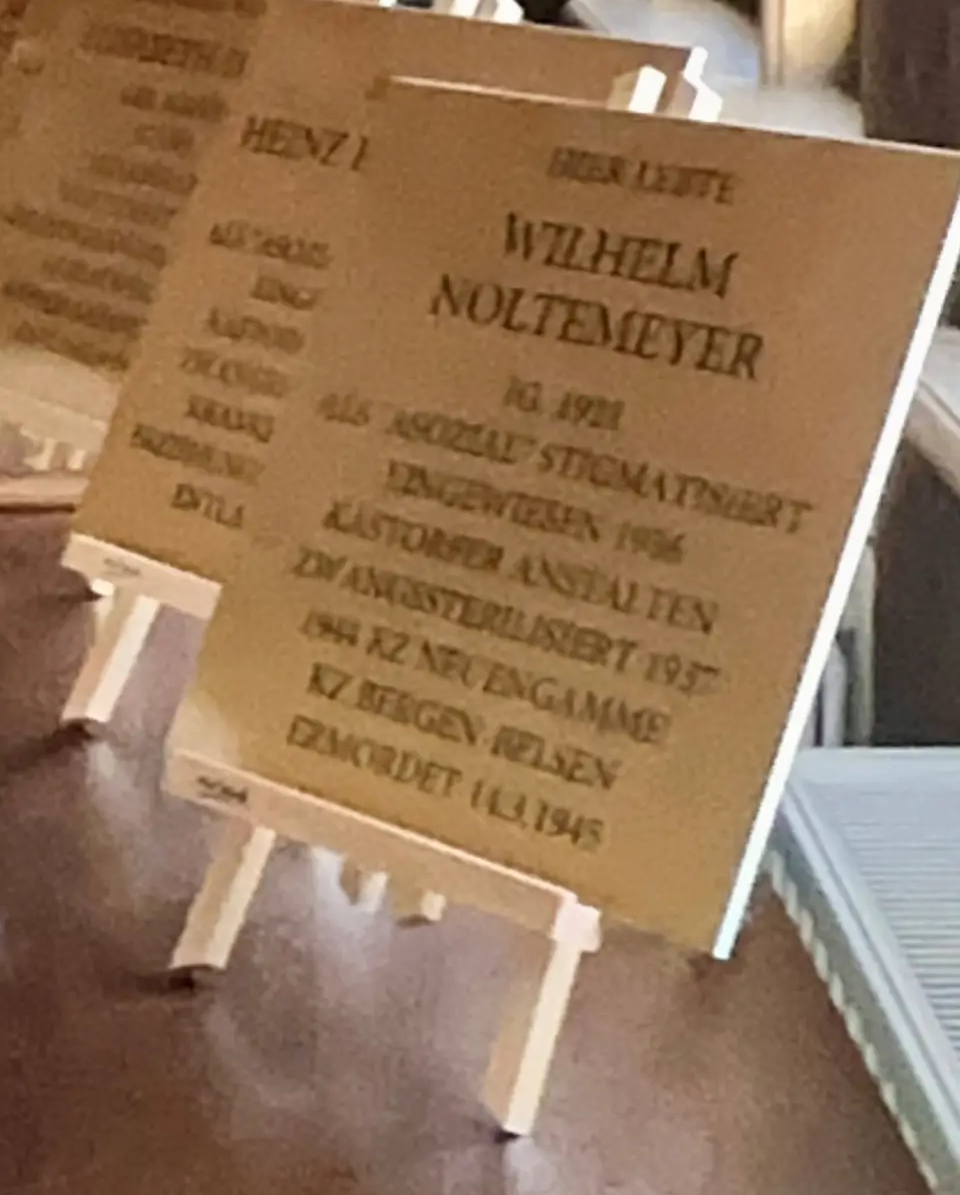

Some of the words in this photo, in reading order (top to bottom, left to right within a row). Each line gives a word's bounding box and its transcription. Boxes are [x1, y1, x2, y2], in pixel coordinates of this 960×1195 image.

[503, 210, 739, 299] WILHELM
[428, 272, 765, 381] NOLTEMEYER
[507, 553, 721, 635] ANSTALTEN
[307, 660, 354, 701] KZ
[366, 624, 411, 665] KZ
[415, 637, 673, 743] NEUENGAMME
[285, 713, 464, 798] ERMORDET
